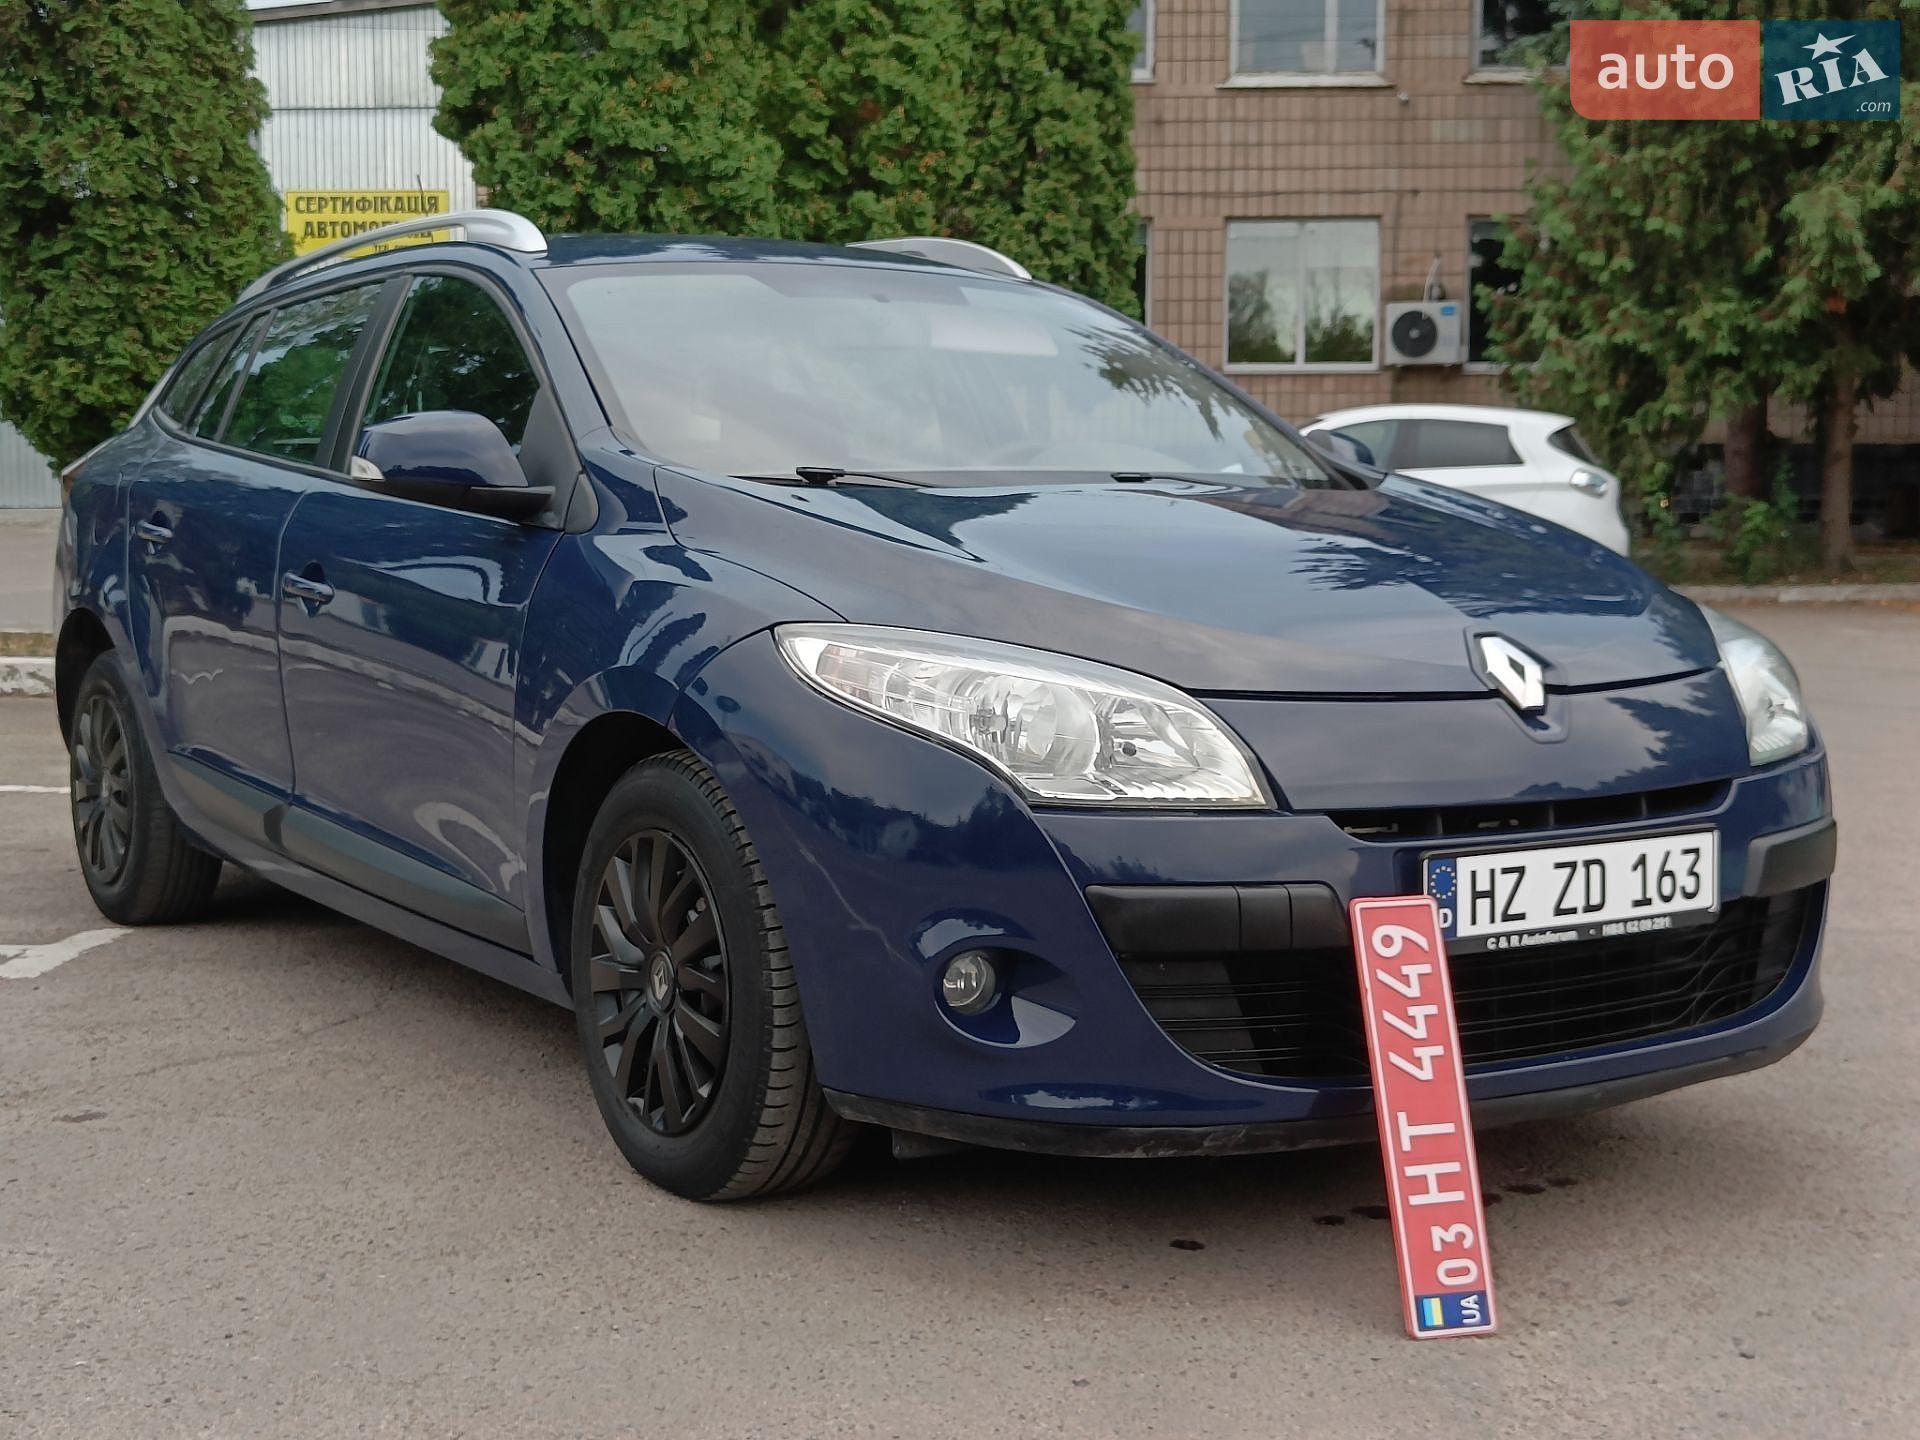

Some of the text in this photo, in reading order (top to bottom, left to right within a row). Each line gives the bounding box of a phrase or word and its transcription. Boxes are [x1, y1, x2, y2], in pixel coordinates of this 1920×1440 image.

[295, 196, 439, 214] СЕРТИФІКАЦІЯ
[1470, 847, 1701, 926] HZ ZD 163
[1371, 924, 1445, 1082] 4449
[1461, 1294, 1481, 1325] UA
